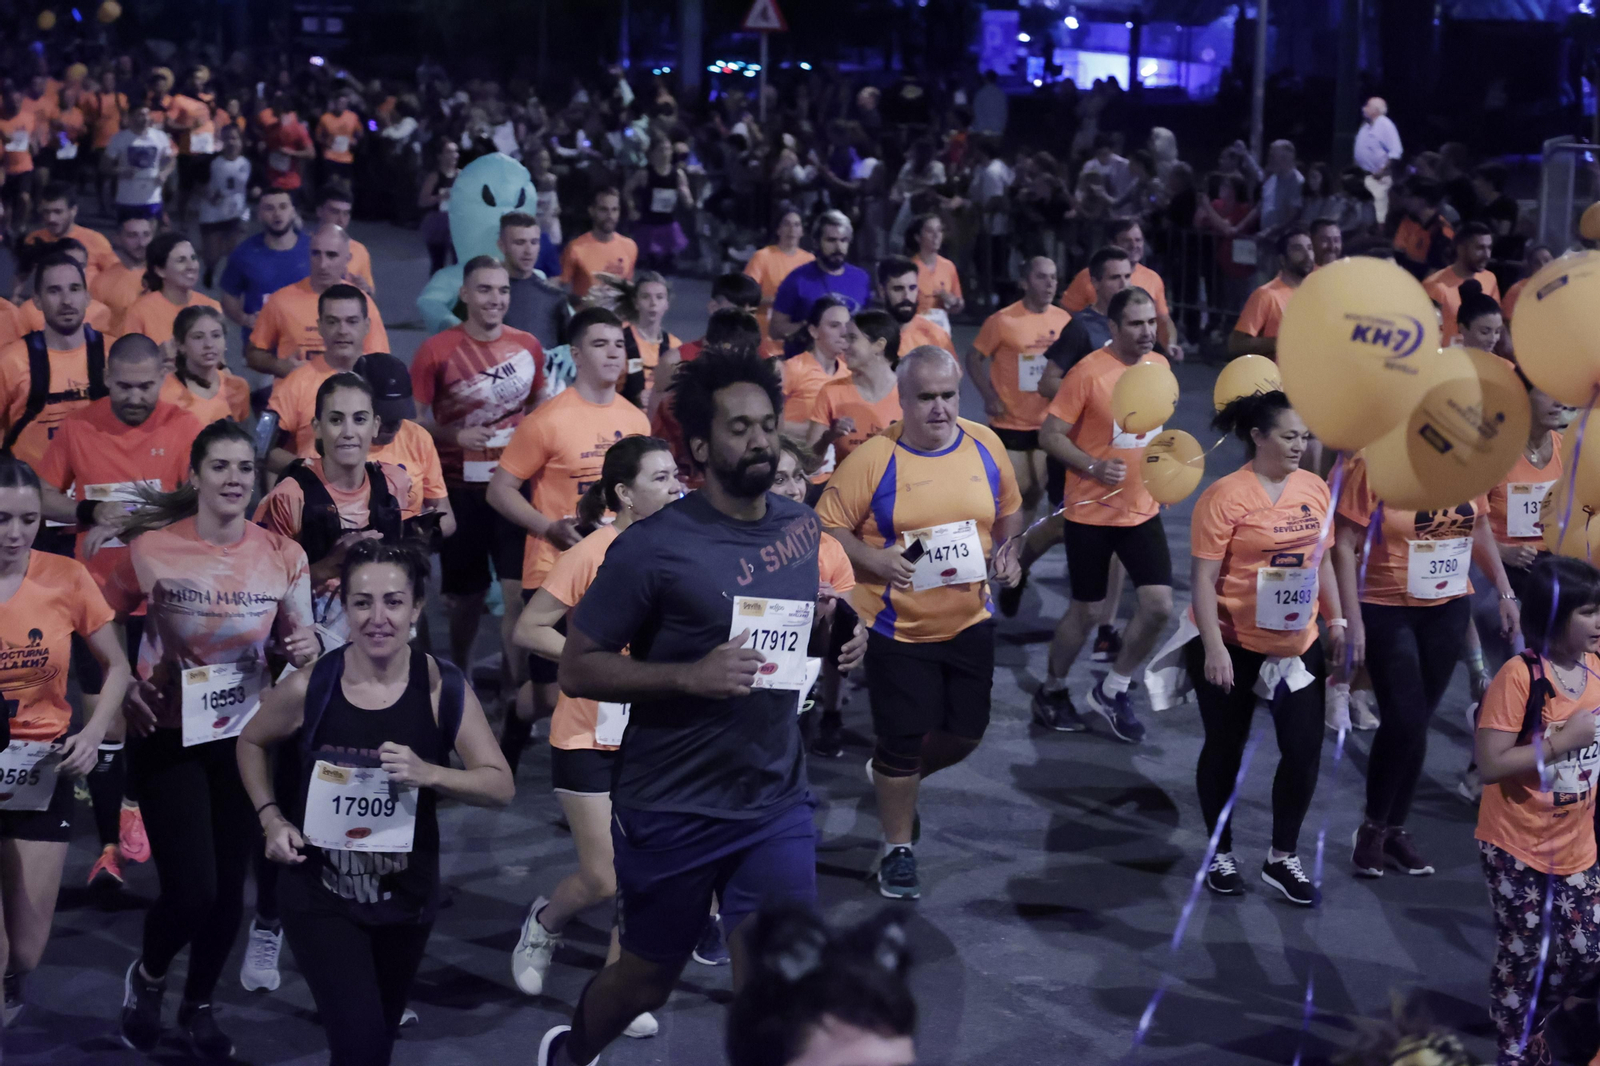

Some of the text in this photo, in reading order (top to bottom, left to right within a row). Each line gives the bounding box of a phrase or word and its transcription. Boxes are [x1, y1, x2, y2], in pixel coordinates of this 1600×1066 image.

[1351, 323, 1411, 352] KH7
[1273, 524, 1304, 533] SEVILLA
[760, 517, 819, 573] SMITH
[926, 542, 969, 563] 14713
[1429, 558, 1458, 574] 3780
[1274, 589, 1312, 605] 12493
[751, 629, 799, 651] 17912
[0, 647, 49, 660] OCTURNA
[201, 686, 246, 710] 16553
[332, 795, 396, 817] 17909
